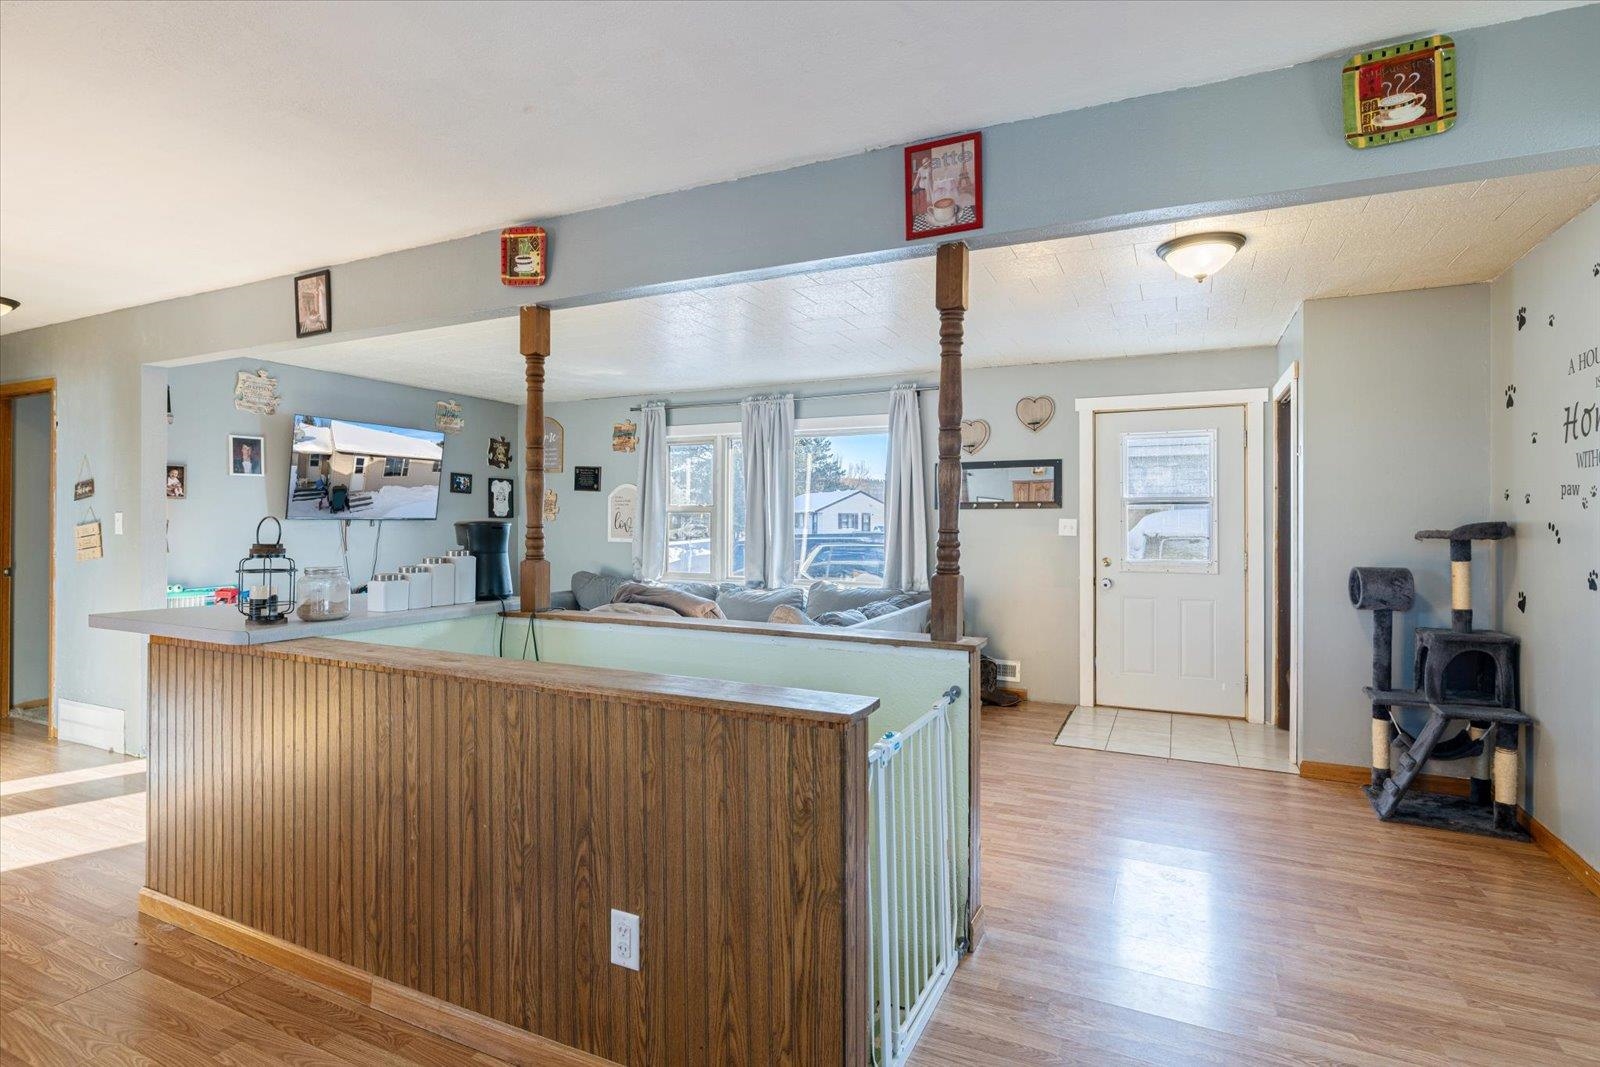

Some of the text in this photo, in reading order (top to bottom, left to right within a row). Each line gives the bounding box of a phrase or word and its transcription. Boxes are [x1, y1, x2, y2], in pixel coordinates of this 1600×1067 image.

[1568, 358, 1575, 375] A
[1576, 449, 1600, 469] WITH
[1561, 484, 1580, 500] paw
